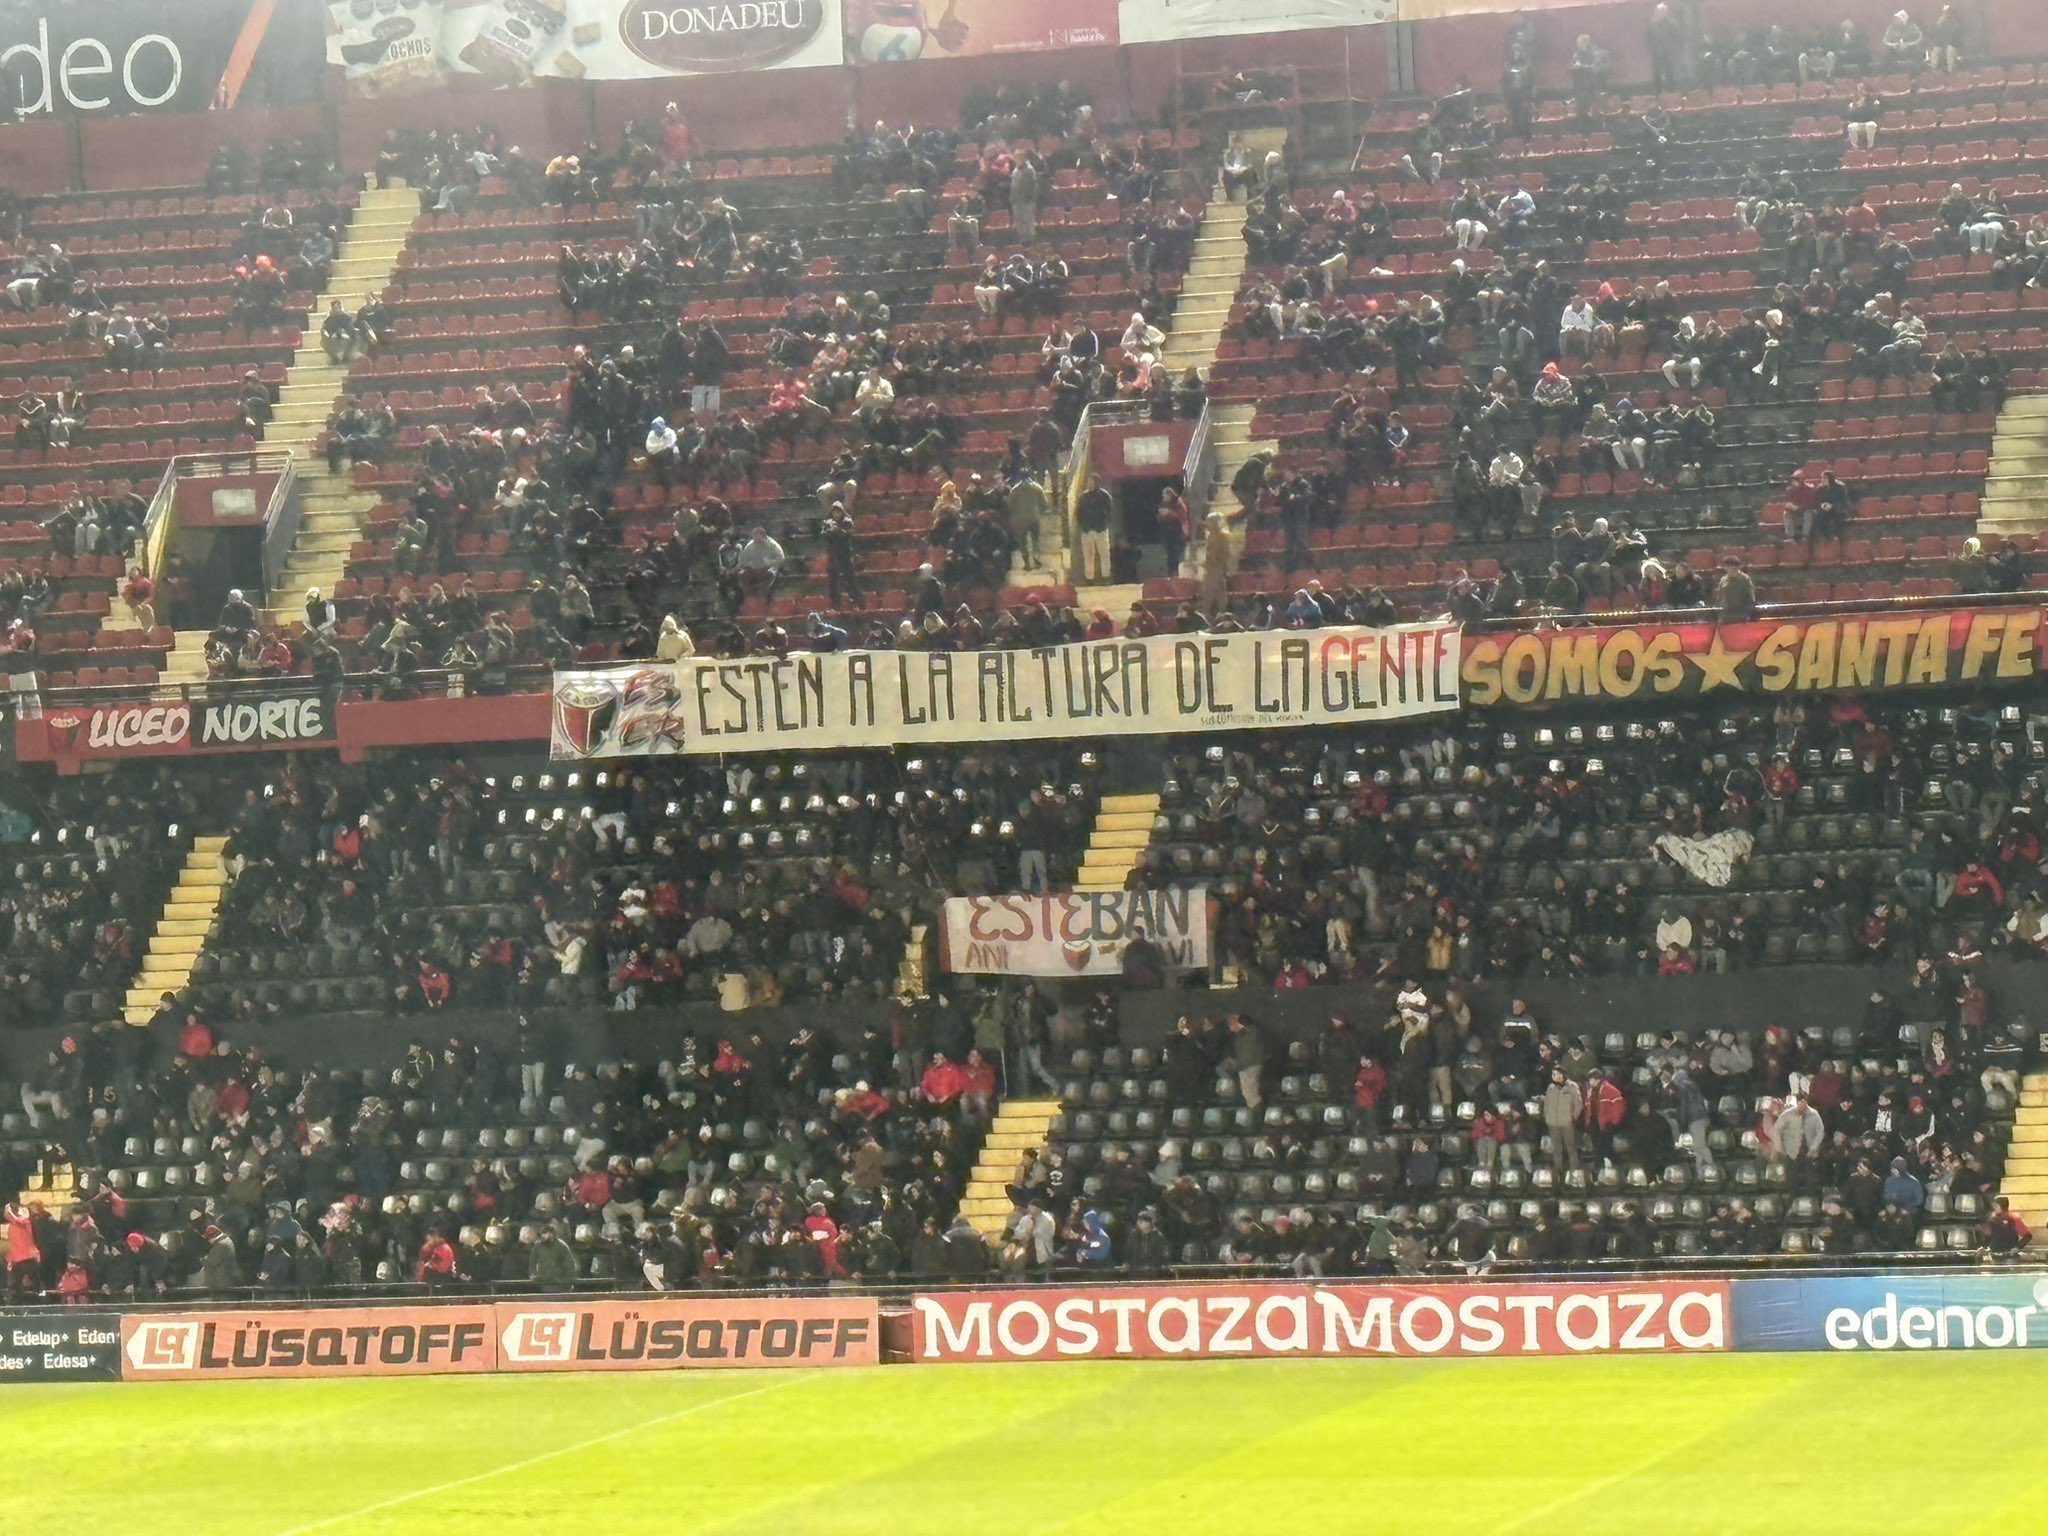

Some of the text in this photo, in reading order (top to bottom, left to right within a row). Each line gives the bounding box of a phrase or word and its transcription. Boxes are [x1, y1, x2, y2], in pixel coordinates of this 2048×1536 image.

[641, 0, 807, 40] DONADEU
[696, 628, 1458, 736] ESTEN A LA ALTURA DE LA GENTE
[1463, 610, 2041, 705] SOMOS SANTA FE
[202, 698, 323, 743] NORTE
[200, 1320, 486, 1369] LÜSQTOFF
[576, 1311, 870, 1361] LÜSQTOFF
[1824, 1291, 2037, 1351] edenor
